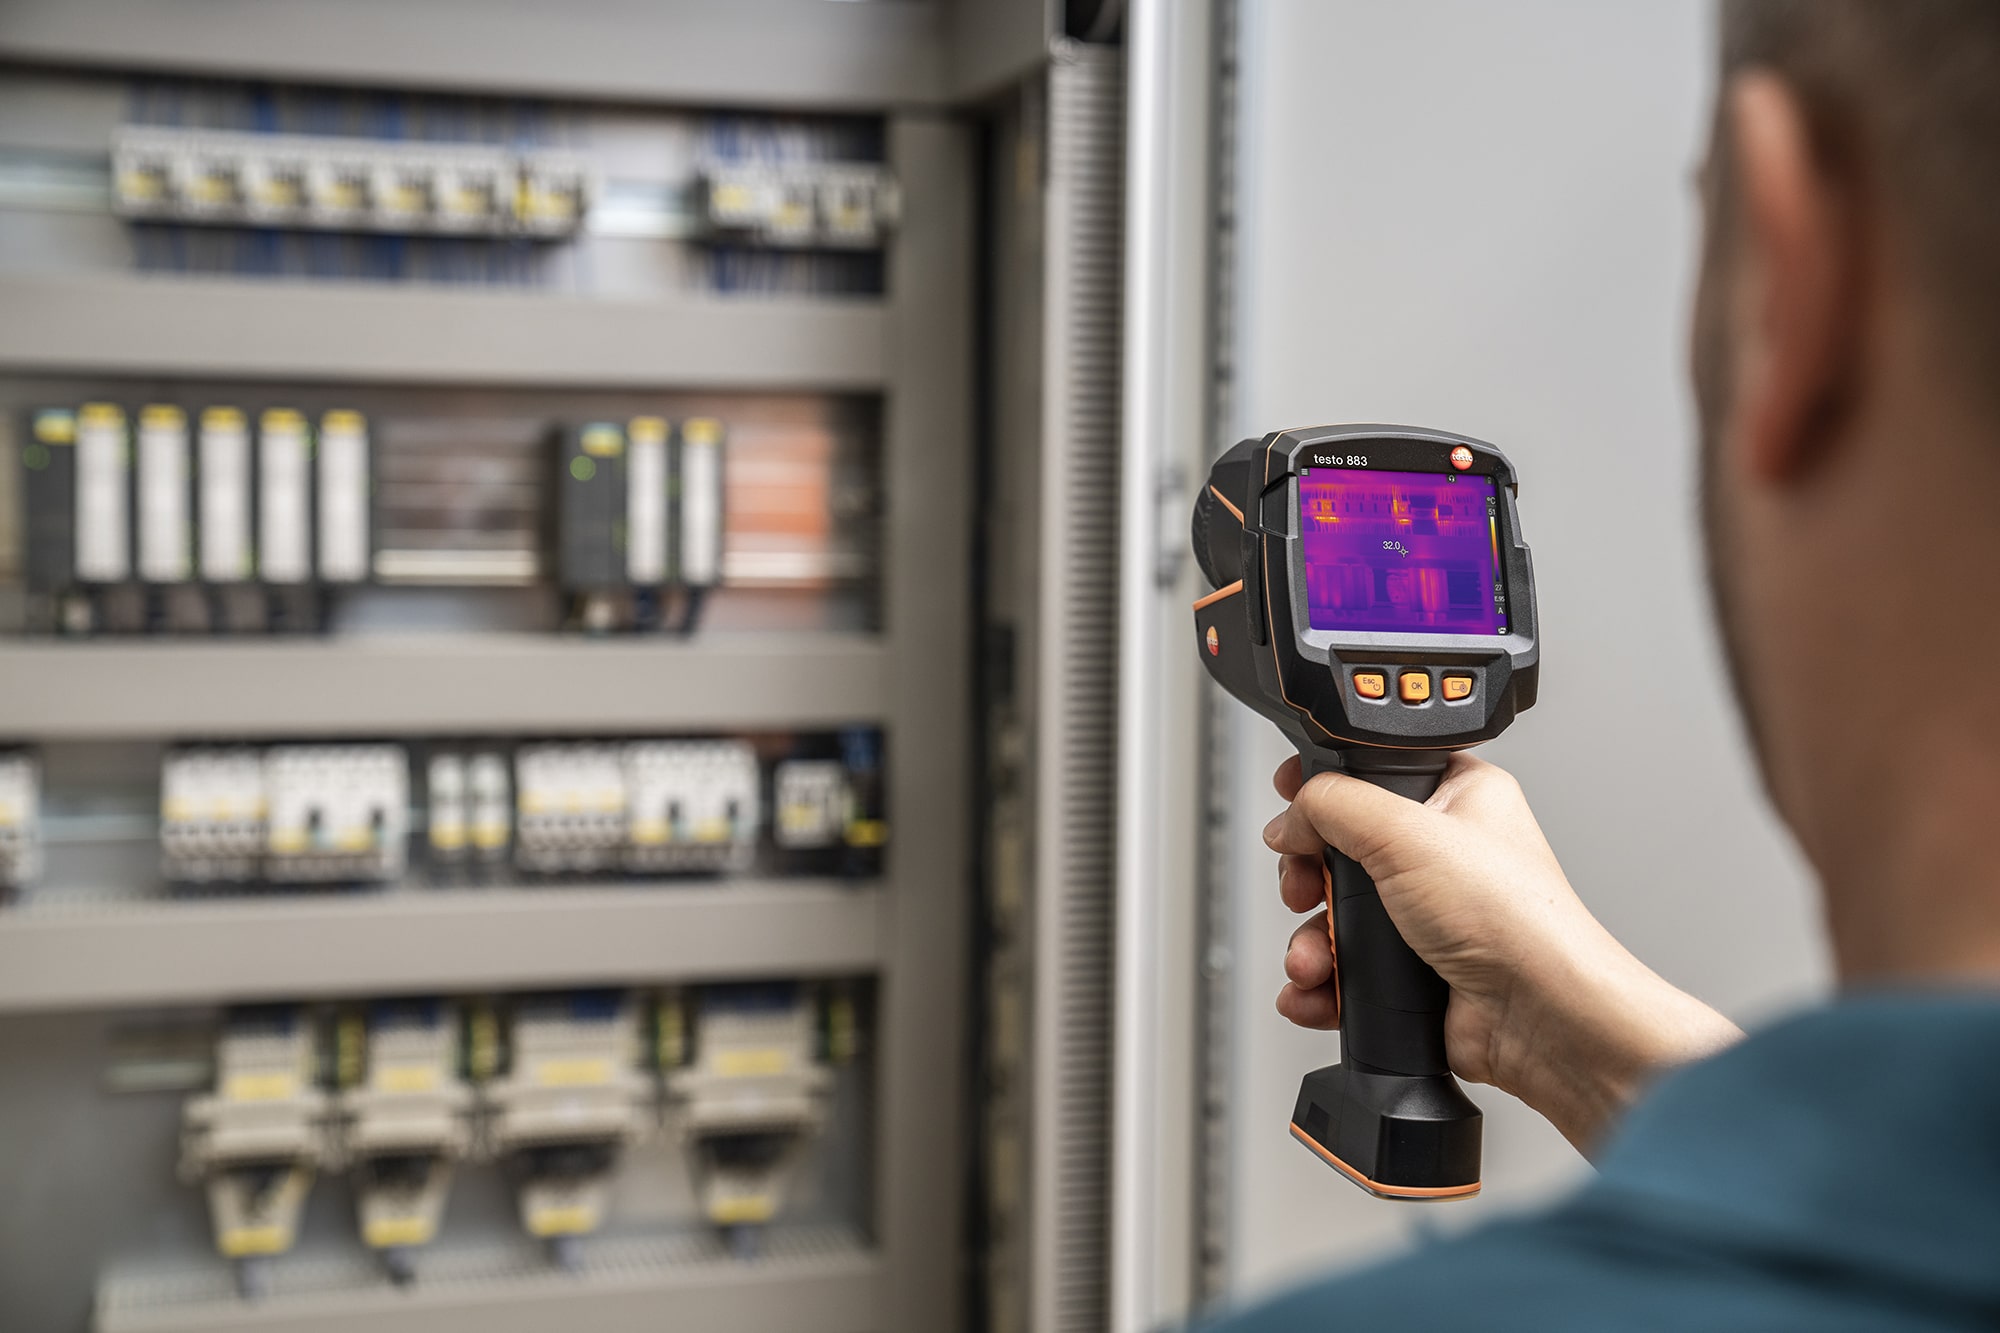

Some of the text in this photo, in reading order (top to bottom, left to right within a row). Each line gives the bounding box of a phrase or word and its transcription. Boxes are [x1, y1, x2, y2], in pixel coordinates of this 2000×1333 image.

[1314, 454, 1368, 466] testo 883
[1382, 540, 1400, 550] 32.0
[1411, 682, 1423, 690] OK
